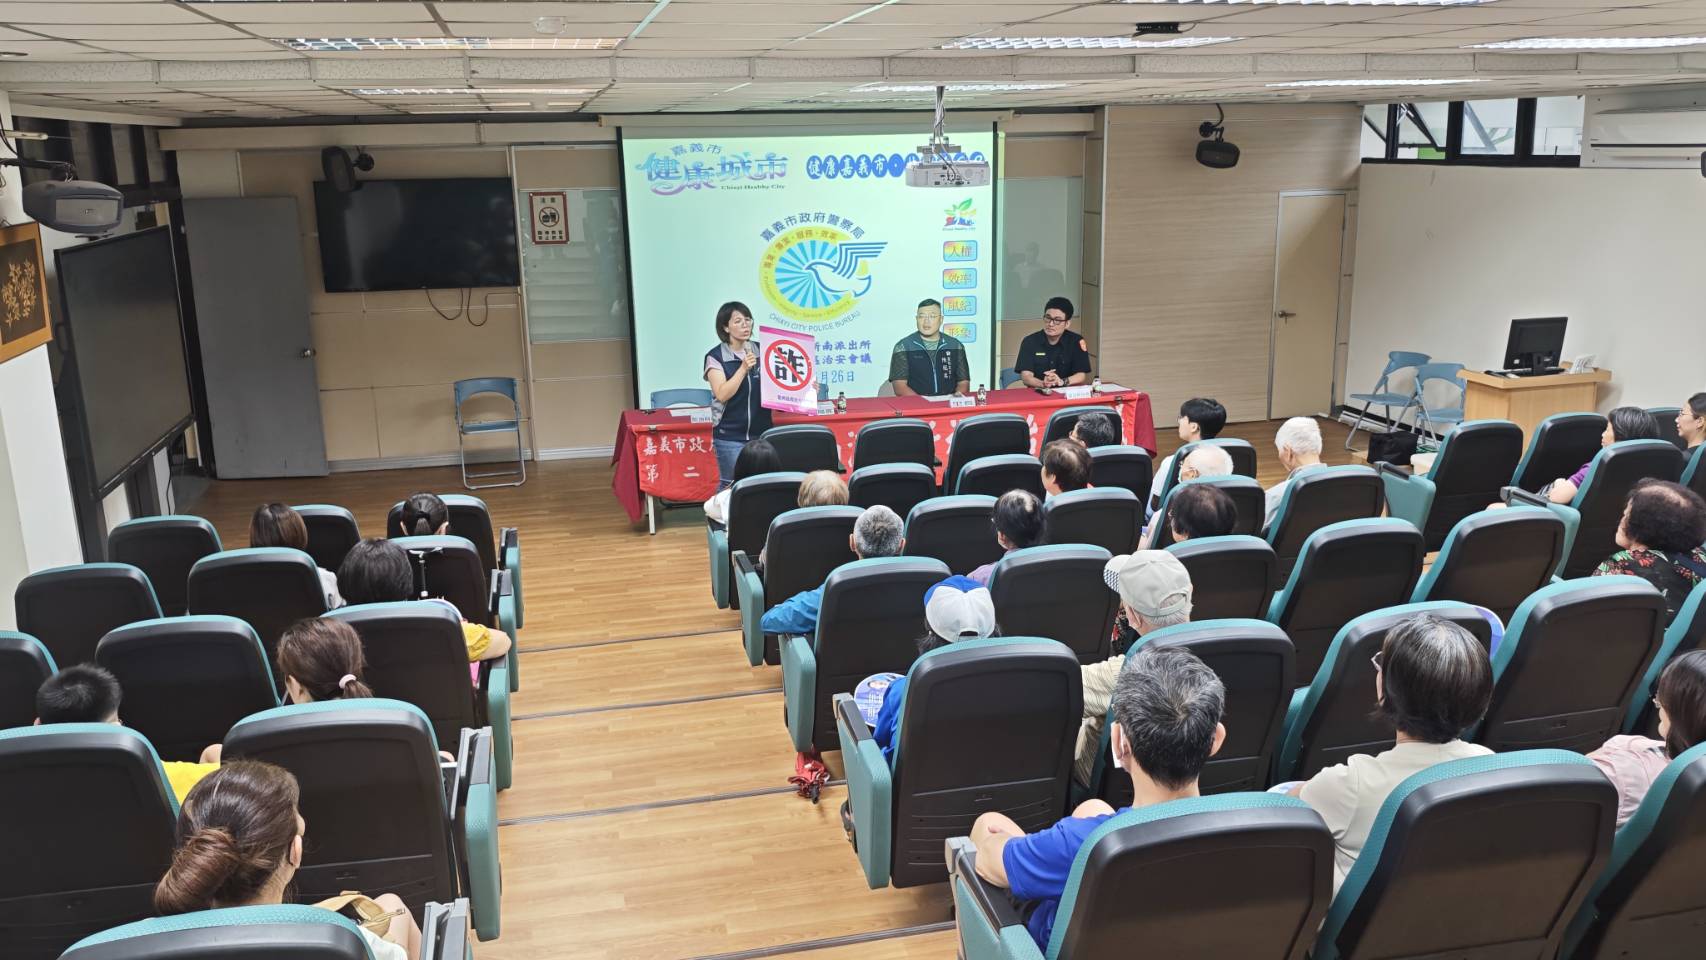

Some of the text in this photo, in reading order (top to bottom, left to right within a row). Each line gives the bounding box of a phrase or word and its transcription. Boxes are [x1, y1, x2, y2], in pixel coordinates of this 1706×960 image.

[635, 152, 788, 195] 健康城市
[760, 212, 865, 241] 嘉義市政府警察局
[791, 323, 807, 331] CITY
[808, 323, 834, 333] POLICE
[834, 310, 861, 329] BUREAU
[774, 347, 805, 383] 詐
[643, 435, 714, 456] 嘉義市政
